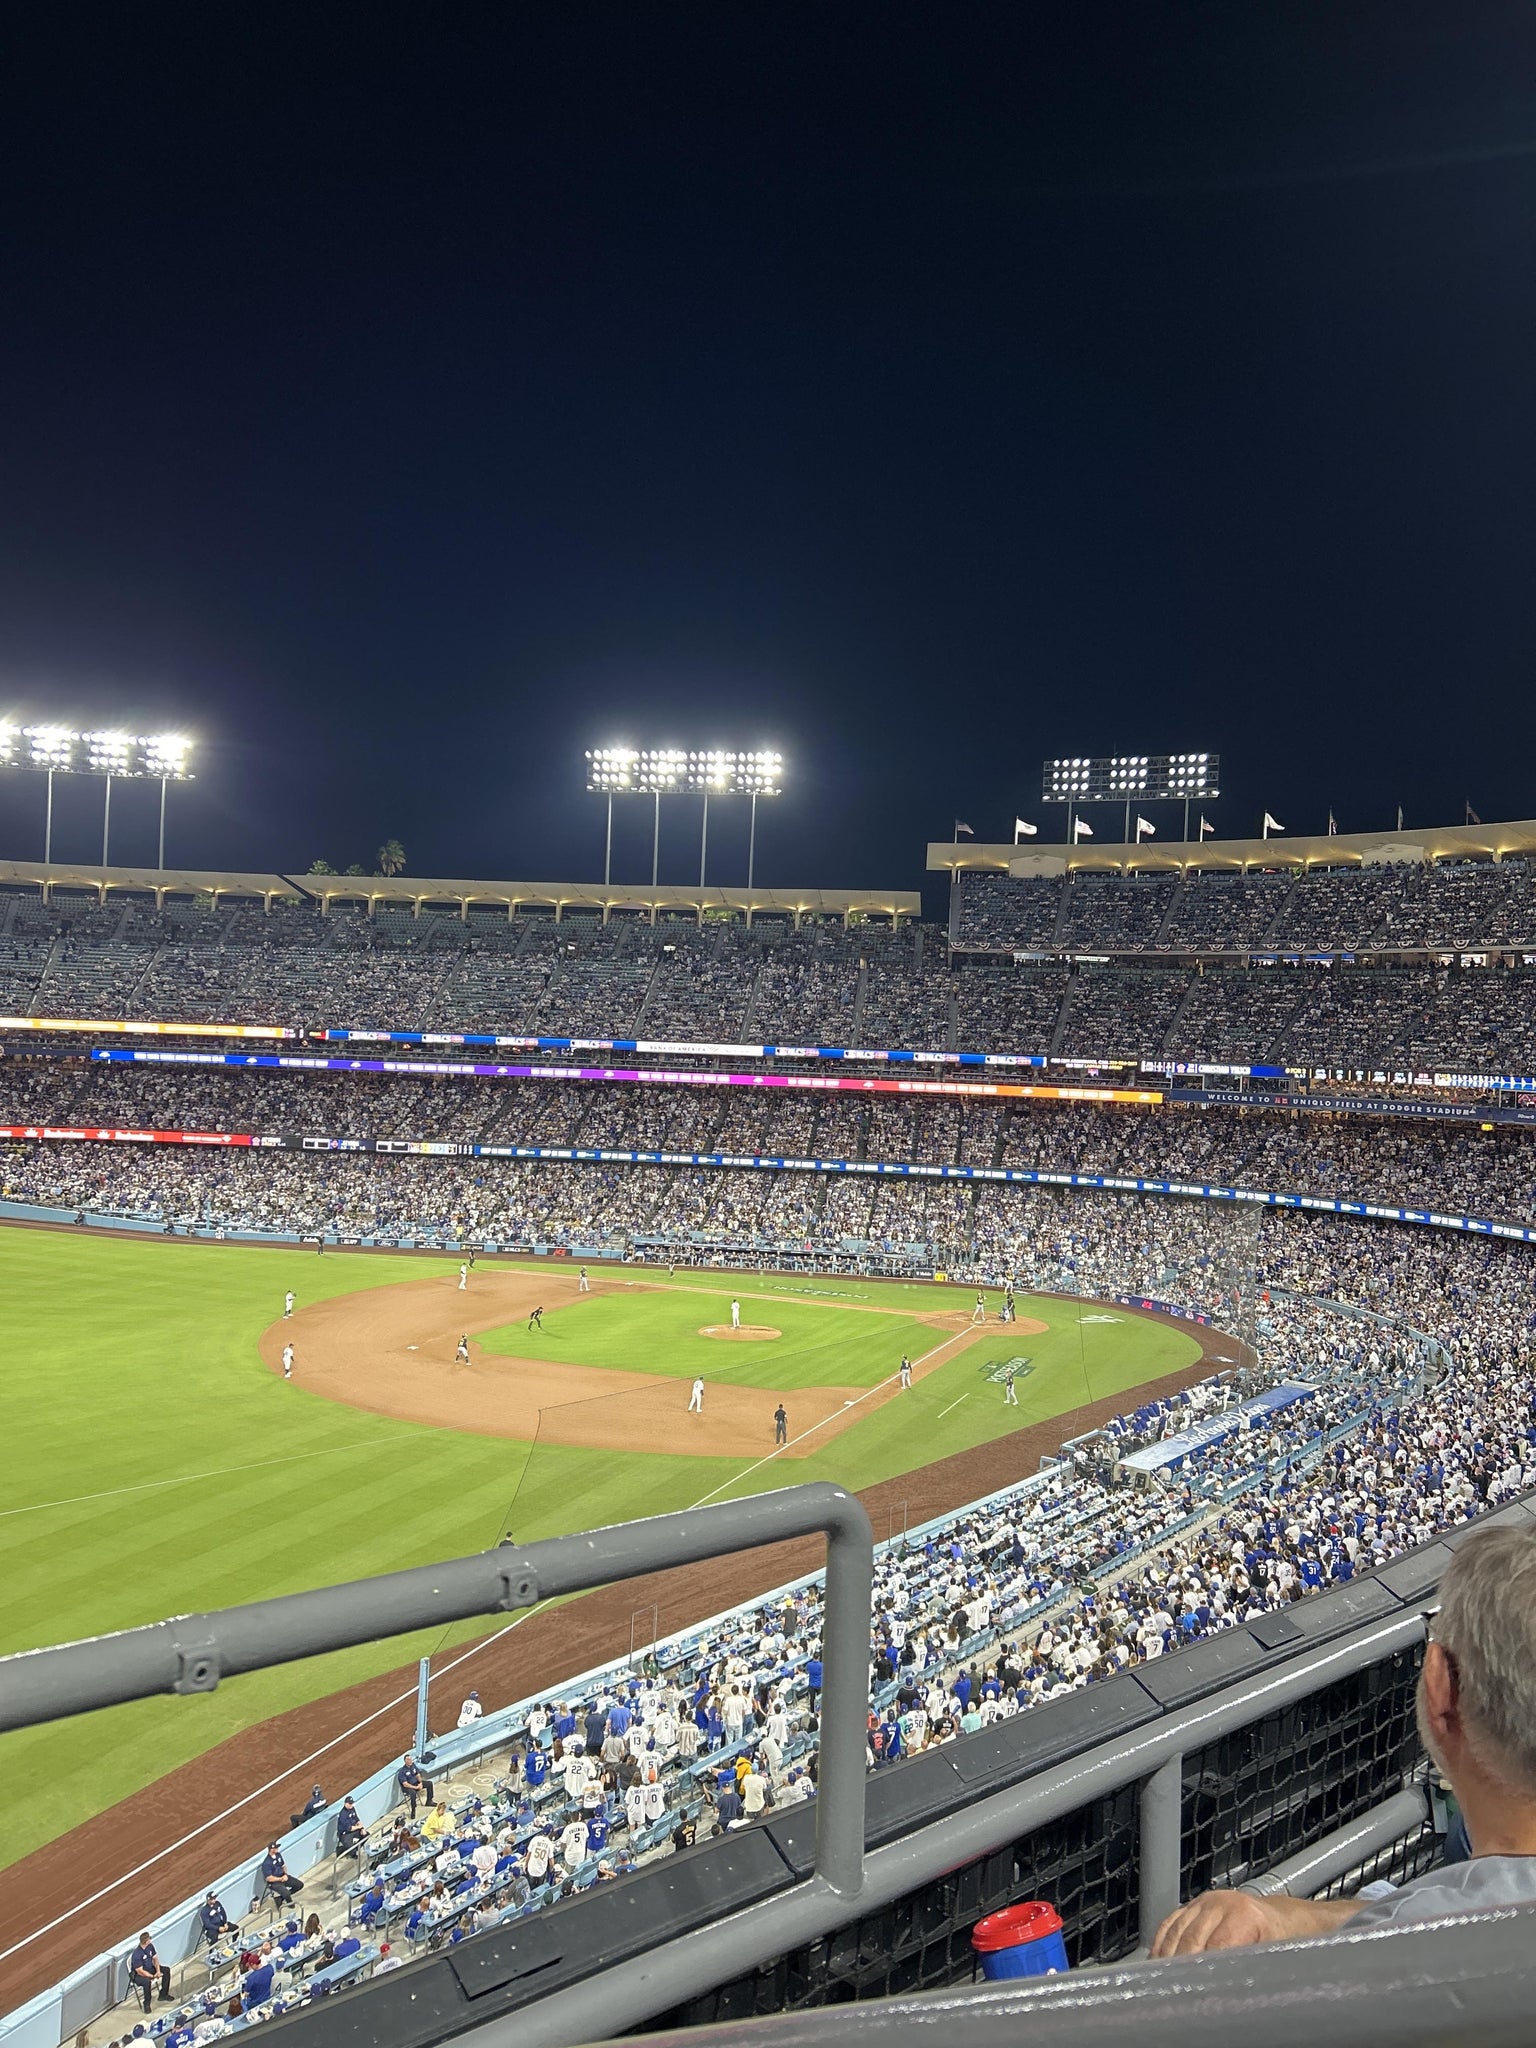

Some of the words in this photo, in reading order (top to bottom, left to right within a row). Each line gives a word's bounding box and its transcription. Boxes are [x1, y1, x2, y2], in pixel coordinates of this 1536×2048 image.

[1208, 1094, 1254, 1102] WELCOME
[1293, 1098, 1332, 1107] UNIQLO
[1335, 1101, 1363, 1109] FIELD
[1382, 1104, 1423, 1113] DODGER
[1426, 1106, 1470, 1116] STADIUM
[633, 1737, 641, 1745] 13
[535, 1760, 545, 1772] 17
[571, 1765, 582, 1775] 22
[648, 1761, 654, 1770] 5
[651, 1794, 657, 1803] 0
[574, 1833, 580, 1843] 5
[595, 1828, 601, 1838] 5
[685, 1833, 693, 1846] 5
[534, 1848, 547, 1861] 50
